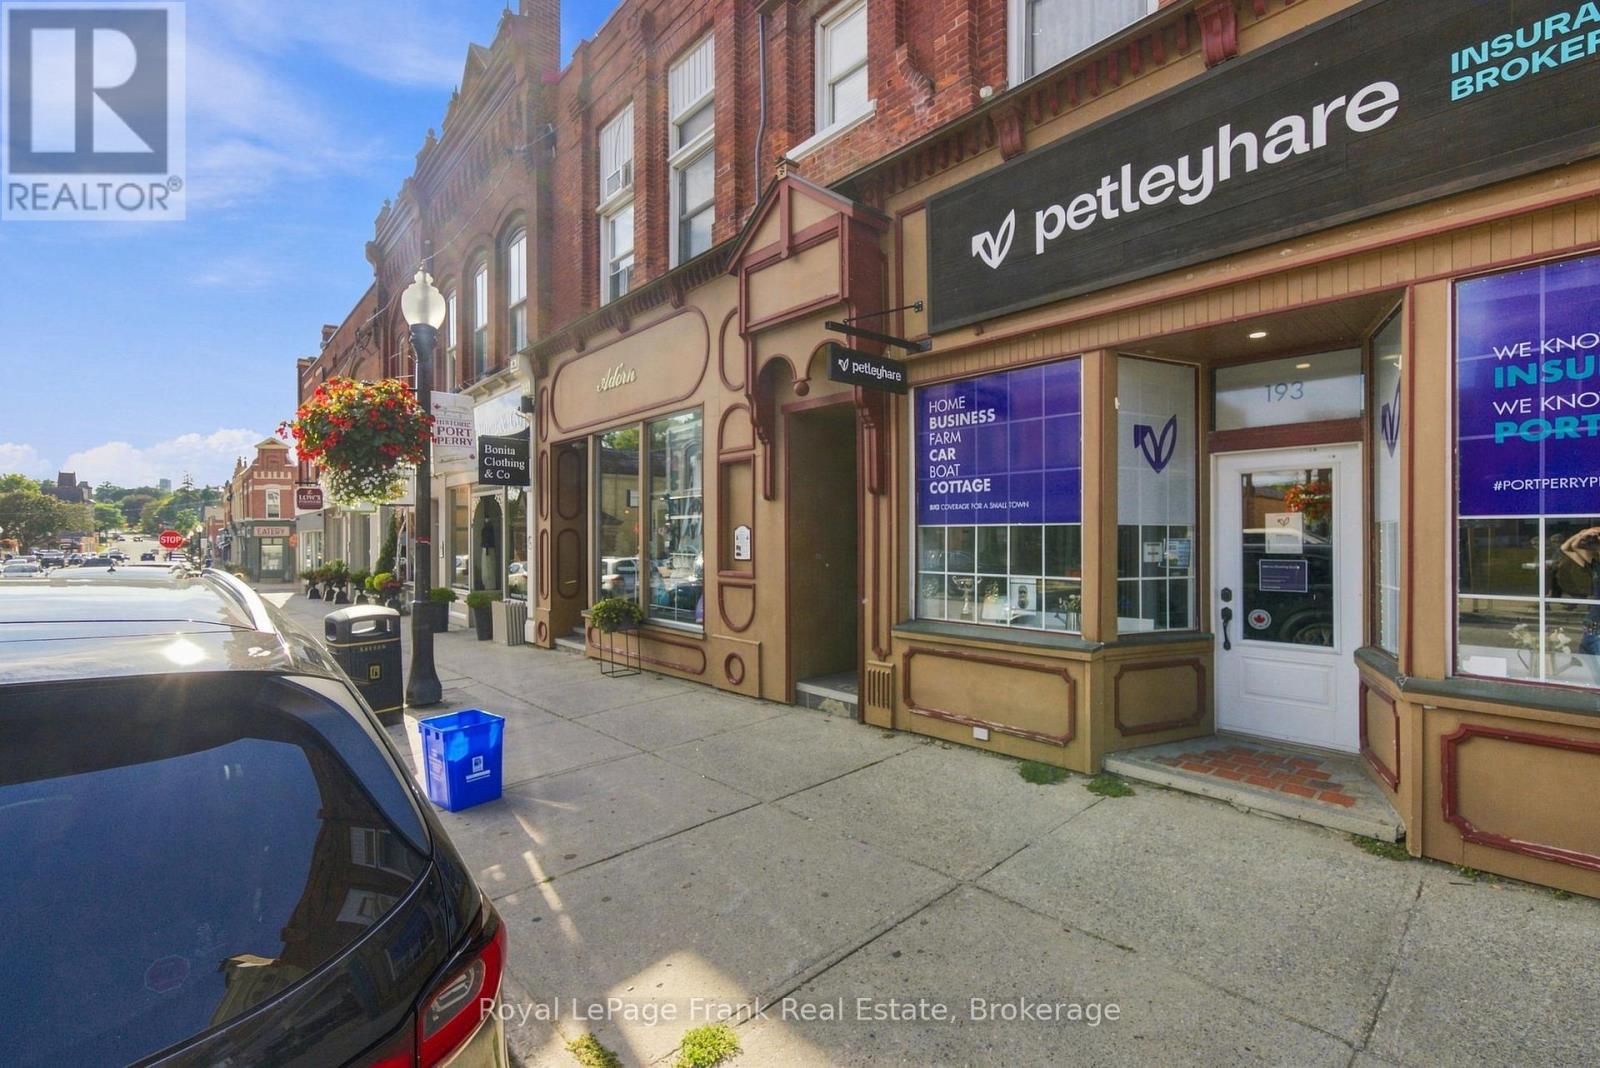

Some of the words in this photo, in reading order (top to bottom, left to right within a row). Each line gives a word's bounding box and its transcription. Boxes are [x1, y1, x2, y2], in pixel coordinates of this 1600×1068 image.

[1451, 1, 1600, 74] INSURA
[1035, 80, 1399, 255] petleyhare
[1493, 341, 1531, 360] WE
[1541, 332, 1600, 354] KNO
[597, 362, 637, 393] Adorn
[852, 361, 902, 382] petleyhare
[1494, 355, 1600, 389] INSU
[1264, 380, 1304, 402] 193
[929, 396, 966, 414] HOME
[1493, 398, 1531, 415] WE
[1541, 391, 1600, 412] KNO
[929, 408, 996, 430] BUSINESS
[437, 426, 472, 438] PORT
[1494, 413, 1600, 444] PORT
[437, 437, 473, 446] PERRY
[929, 431, 961, 446] FARM
[484, 444, 516, 456] Bonita
[929, 448, 956, 462] CAR
[484, 457, 525, 471] Clothing
[929, 464, 961, 478] BOAT
[484, 469, 494, 479] &
[496, 470, 511, 480] Co
[929, 479, 991, 494] COTTAGE
[1493, 476, 1600, 491] #PORTPERRYP
[941, 502, 970, 511] COVERAGE
[971, 502, 983, 510] FOR
[983, 502, 989, 510] A
[989, 501, 1007, 509] SMALL
[161, 536, 181, 544] STOP
